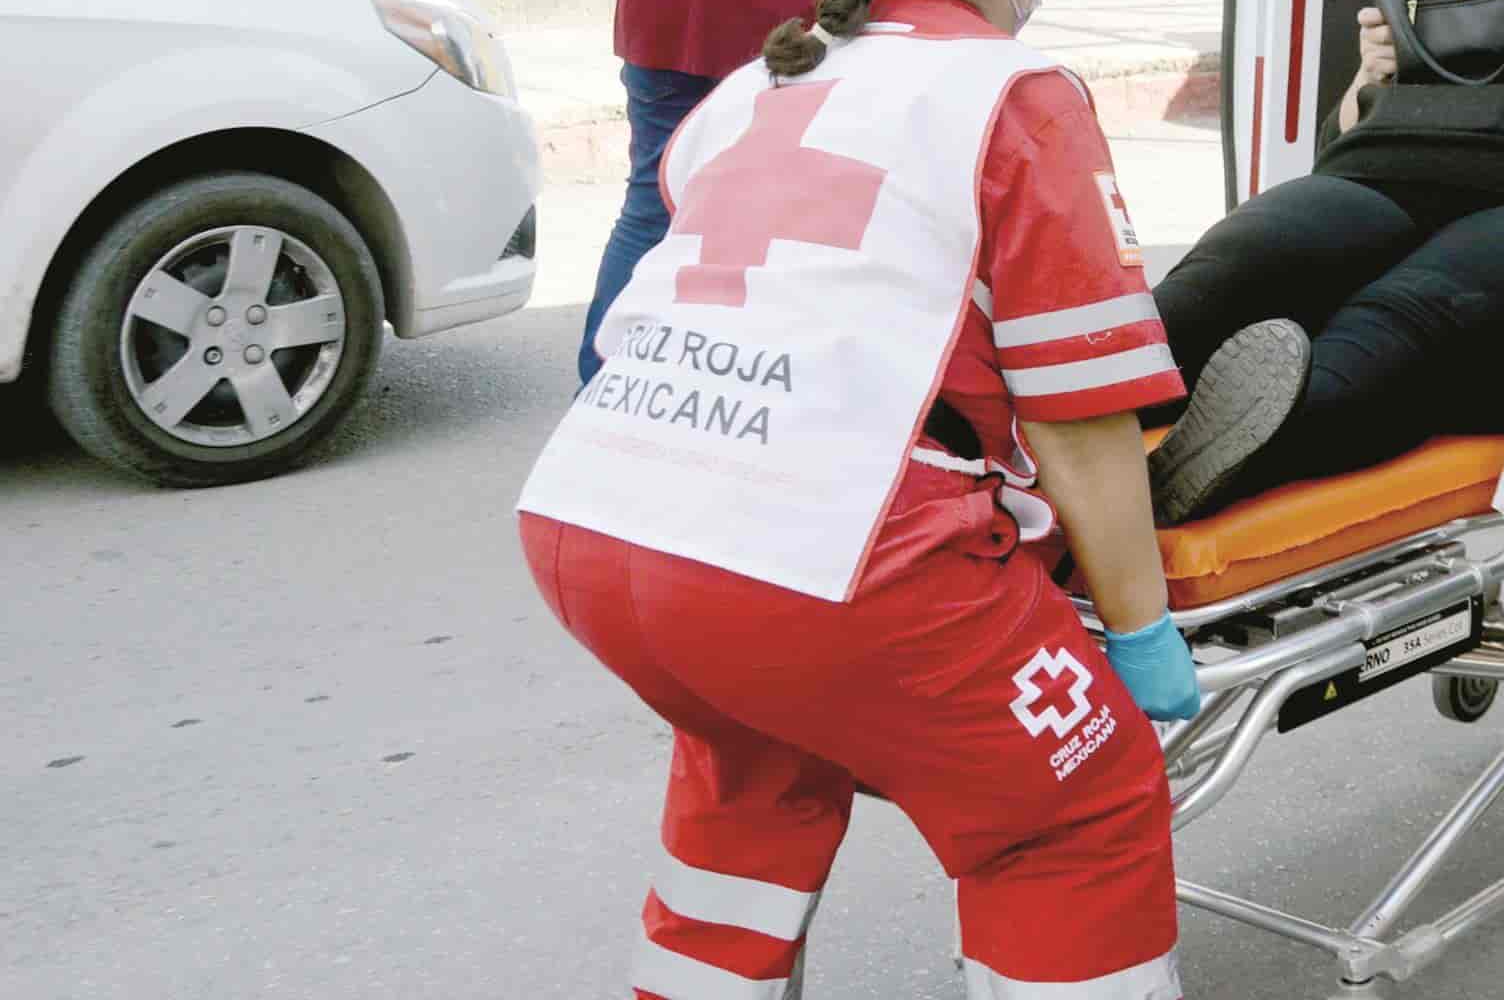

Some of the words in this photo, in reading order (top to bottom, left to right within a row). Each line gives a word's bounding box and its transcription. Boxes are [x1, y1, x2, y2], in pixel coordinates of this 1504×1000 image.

[678, 330, 793, 393] ROJA
[1049, 734, 1083, 768] CRUZ
[1081, 703, 1112, 740] ROJA
[1055, 716, 1118, 782] MEXICANA
